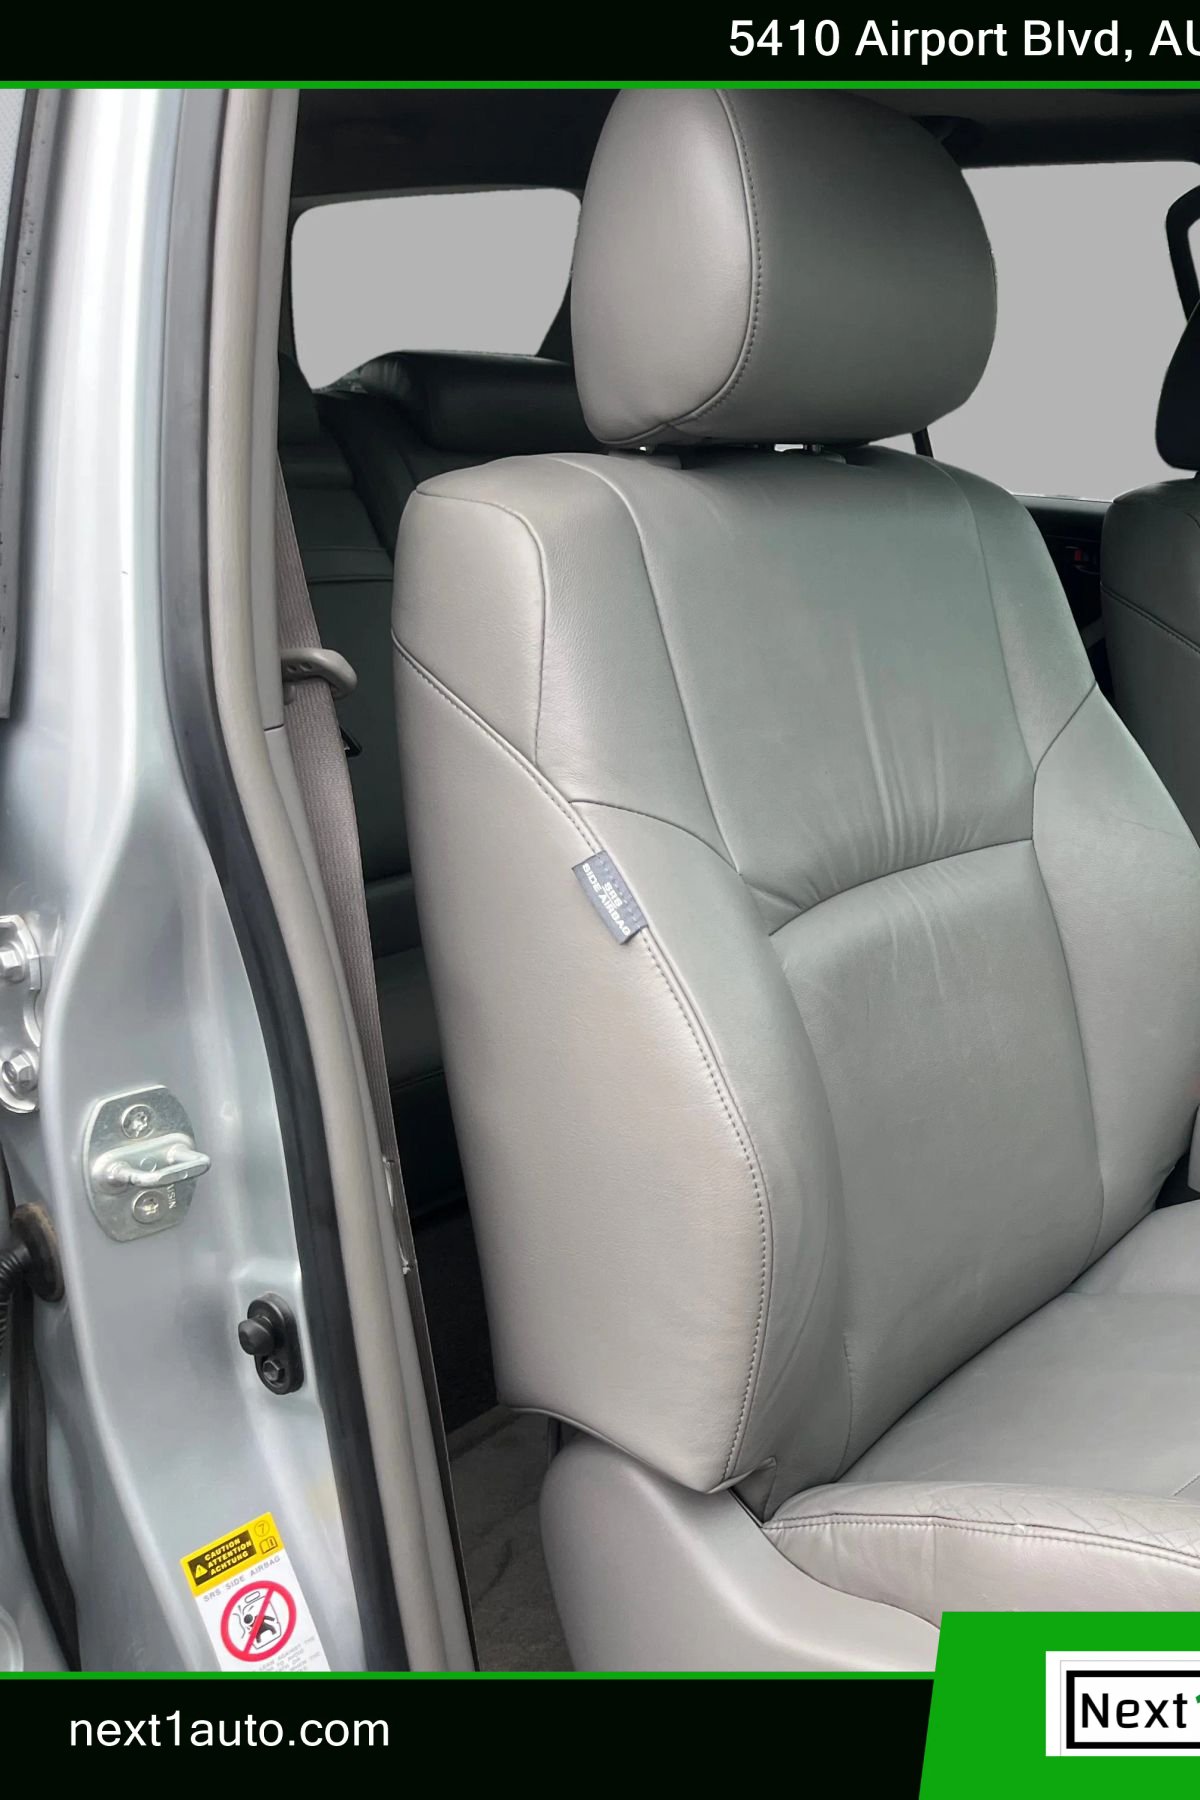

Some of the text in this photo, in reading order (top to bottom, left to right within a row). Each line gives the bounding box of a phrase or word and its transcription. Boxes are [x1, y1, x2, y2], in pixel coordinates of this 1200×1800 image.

[582, 862, 632, 936] SIDE AIRBAG
[604, 881, 623, 907] SRS
[204, 1537, 242, 1562] CAUTION
[207, 1539, 253, 1569] ATTENTION
[210, 1550, 250, 1576] ACHTUNG
[203, 1554, 281, 1602] SRS SIDE AIRBAG
